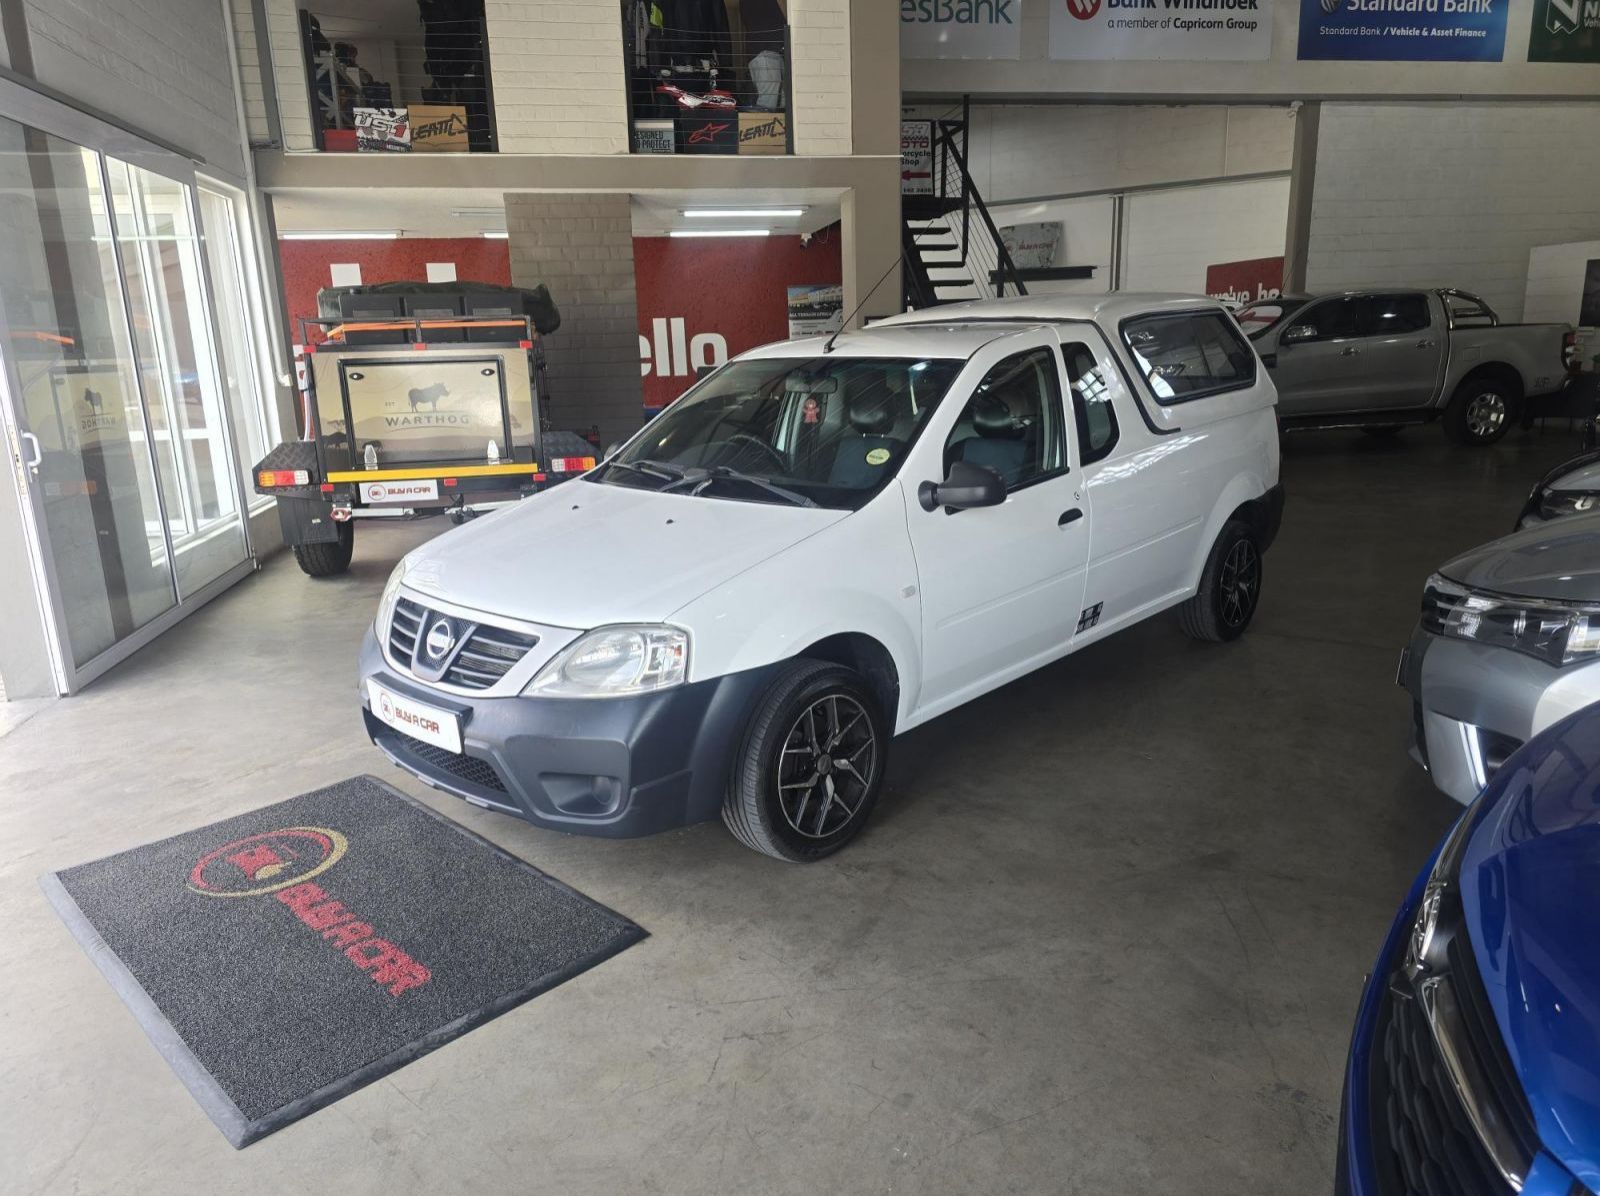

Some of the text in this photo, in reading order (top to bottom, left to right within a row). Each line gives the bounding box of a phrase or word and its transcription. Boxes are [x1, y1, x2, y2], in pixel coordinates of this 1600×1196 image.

[1443, 0, 1492, 13] Bank
[1584, 1, 1600, 18] N
[1107, 17, 1258, 33] a member of Capricorn Group
[1320, 26, 1359, 35] Standard
[1360, 27, 1381, 36] Bank
[1390, 27, 1420, 36] Vehicle
[1421, 28, 1429, 37] &
[1430, 28, 1453, 37] Asset
[1454, 28, 1487, 38] Finance
[385, 415, 470, 427] WARTHOG
[388, 487, 406, 495] BUY
[413, 486, 431, 494] CAR
[395, 706, 412, 724] BUY
[420, 717, 440, 734] CAR
